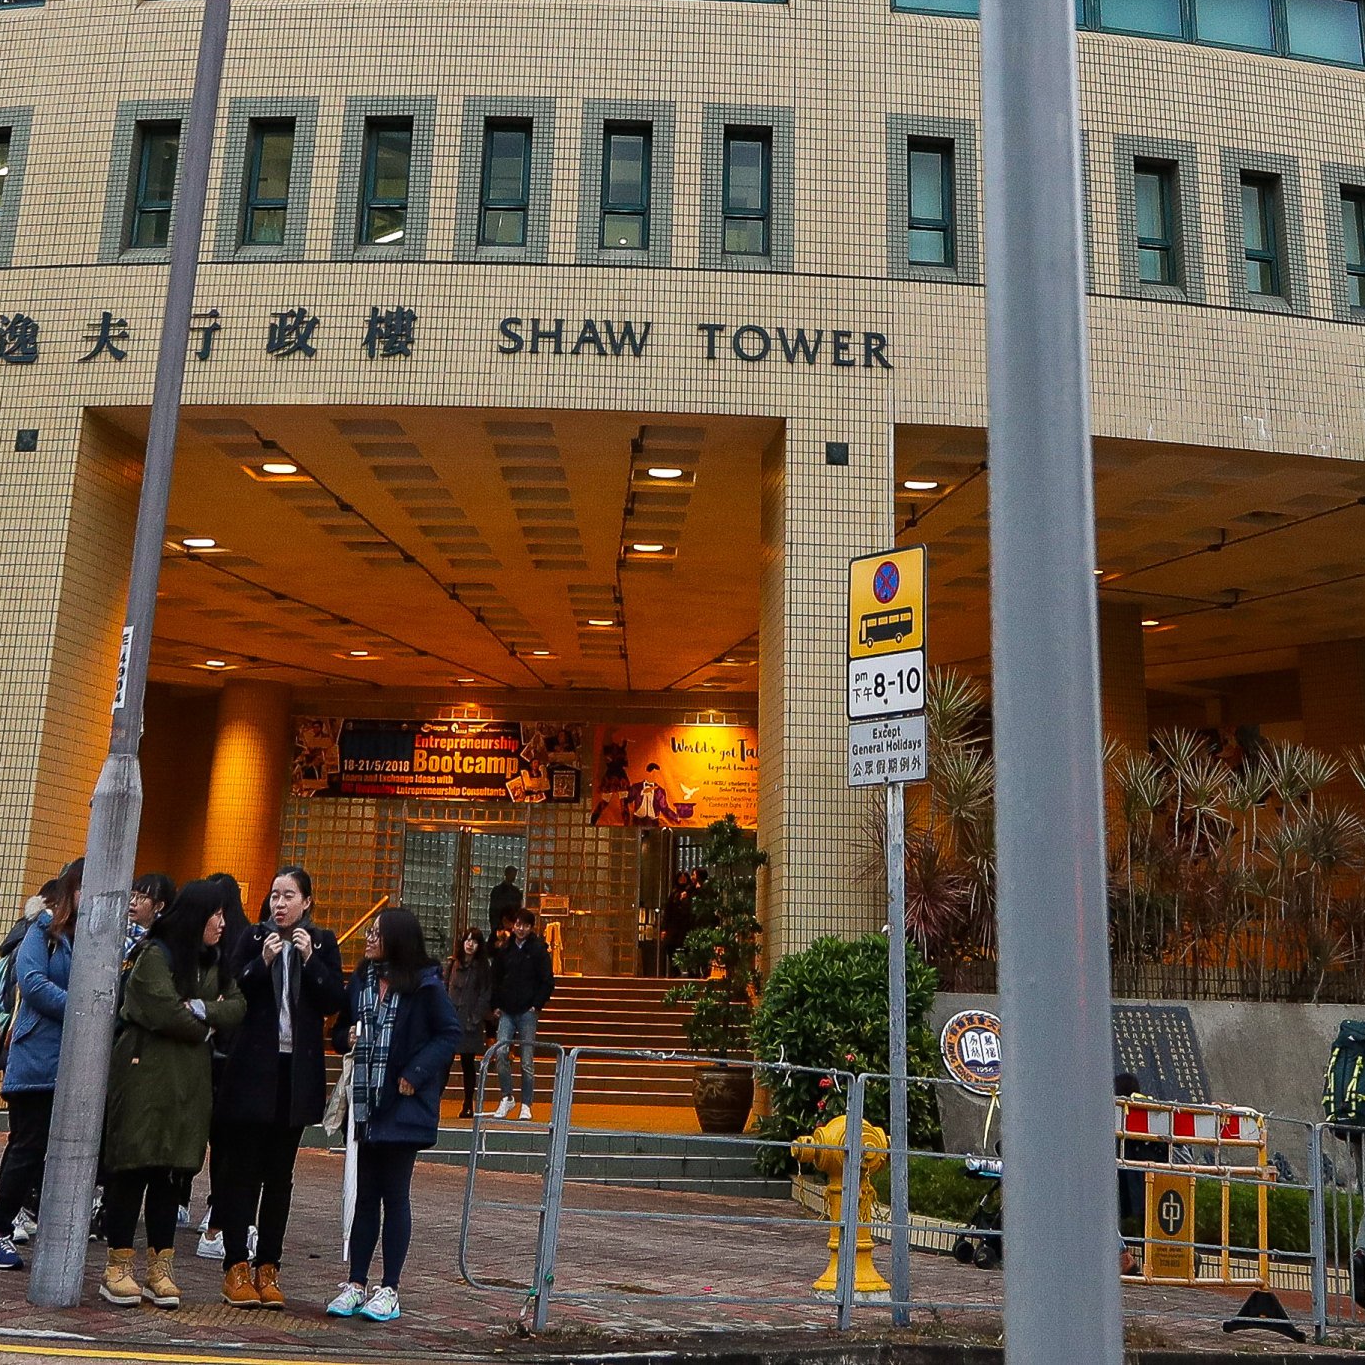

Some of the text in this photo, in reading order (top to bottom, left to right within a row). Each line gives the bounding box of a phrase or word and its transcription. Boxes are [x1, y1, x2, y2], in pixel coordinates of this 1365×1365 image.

[499, 317, 894, 369] SHAW TOWER
[855, 667, 921, 698] pm 8-10
[853, 687, 872, 703] 下午
[872, 725, 901, 740] Except
[415, 734, 519, 752] Entrepreneurship
[671, 737, 715, 753] World's
[852, 739, 922, 756] General Holidays
[344, 759, 410, 773] 18-21/5/2018
[413, 749, 519, 778] Bootcamp
[379, 774, 414, 784] Exchange
[415, 774, 436, 784] Ideas
[437, 775, 453, 784] with
[396, 784, 460, 796] Entrepreneurship
[461, 786, 506, 797] Consultants
